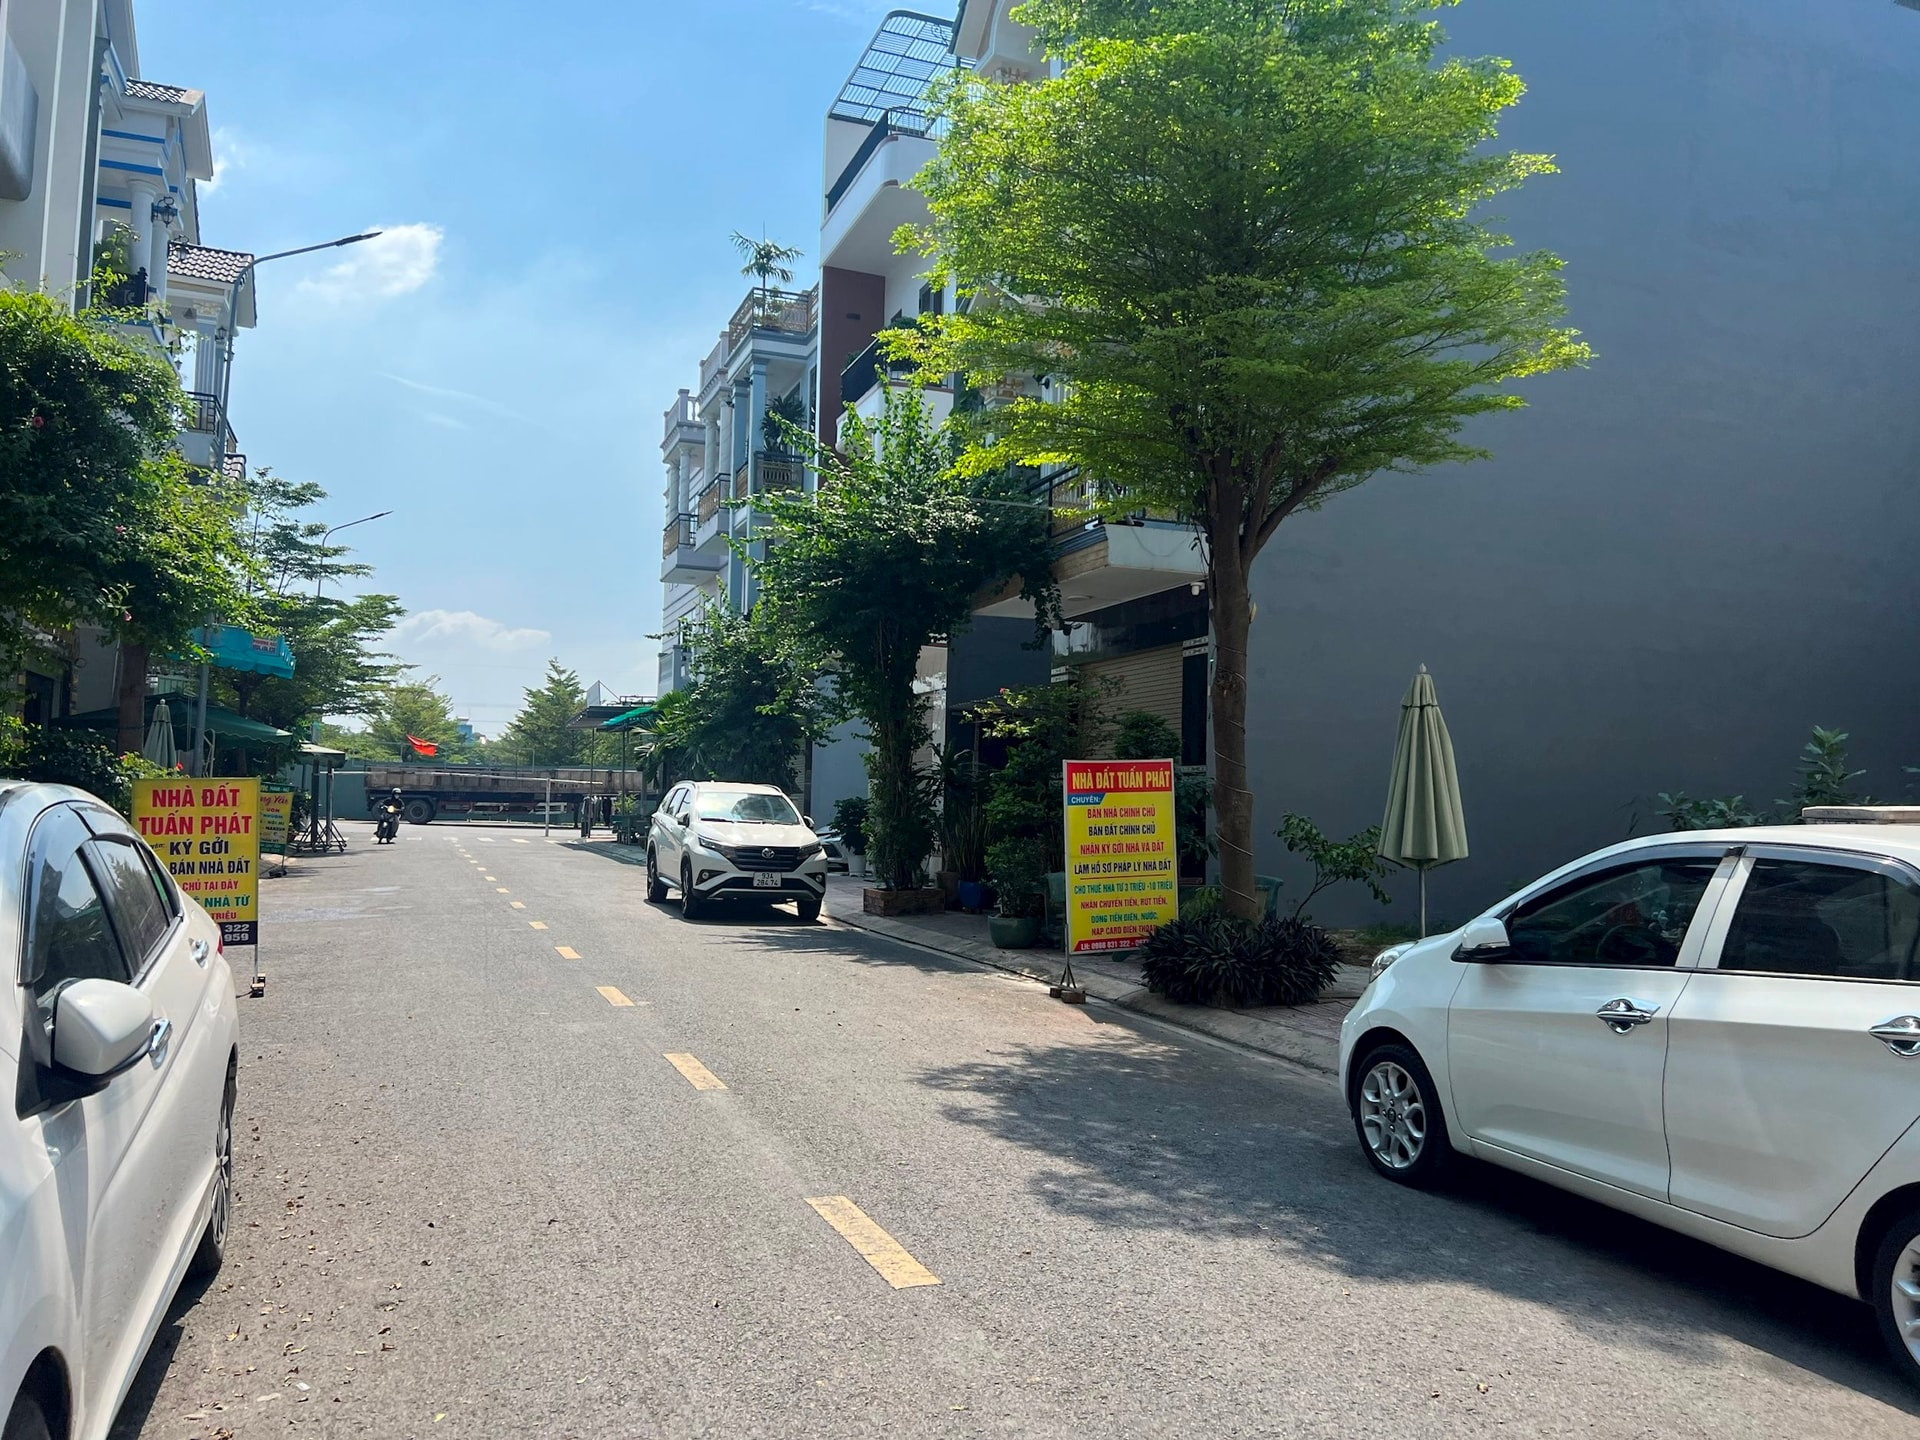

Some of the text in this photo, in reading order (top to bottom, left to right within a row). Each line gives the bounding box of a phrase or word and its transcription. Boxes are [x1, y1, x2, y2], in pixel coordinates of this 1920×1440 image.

[1072, 765, 1170, 789] NHÀ ĐẤT TUẤN PHÁT
[152, 782, 240, 807] NHÀ ĐẤT
[1071, 795, 1101, 804] CHUYÊN:
[1087, 804, 1156, 819] BÁN NHÀ CHÍNH CHỦ
[139, 810, 252, 835] TUẤN PHÁT
[1088, 821, 1156, 836] BÁN ĐẤT CHÍNH CHỦ
[170, 839, 193, 855] KÝ
[199, 836, 229, 854] GỞI
[1080, 842, 1100, 856] NHẬN
[1101, 841, 1111, 853] KÝ
[1125, 841, 1140, 853] NHÀ
[1141, 841, 1150, 852] VÀ
[1151, 840, 1165, 852] ĐẤT
[170, 855, 250, 875] BÁN NHÀ ĐẤT
[1074, 857, 1171, 875] LÀM HỒ SƠ PHÁP LÝ NHÀ ĐẤT
[182, 879, 239, 892] CHỦ TẠI ĐÂY
[1074, 885, 1086, 894] CHO
[1102, 882, 1115, 893] NHÀ
[1125, 883, 1128, 891] 3
[204, 895, 230, 908] NHÀ
[234, 894, 250, 906] TỪ
[224, 924, 250, 933] 322
[1106, 926, 1122, 935] CARD
[223, 933, 249, 942] 959
[1119, 939, 1130, 948] 322
